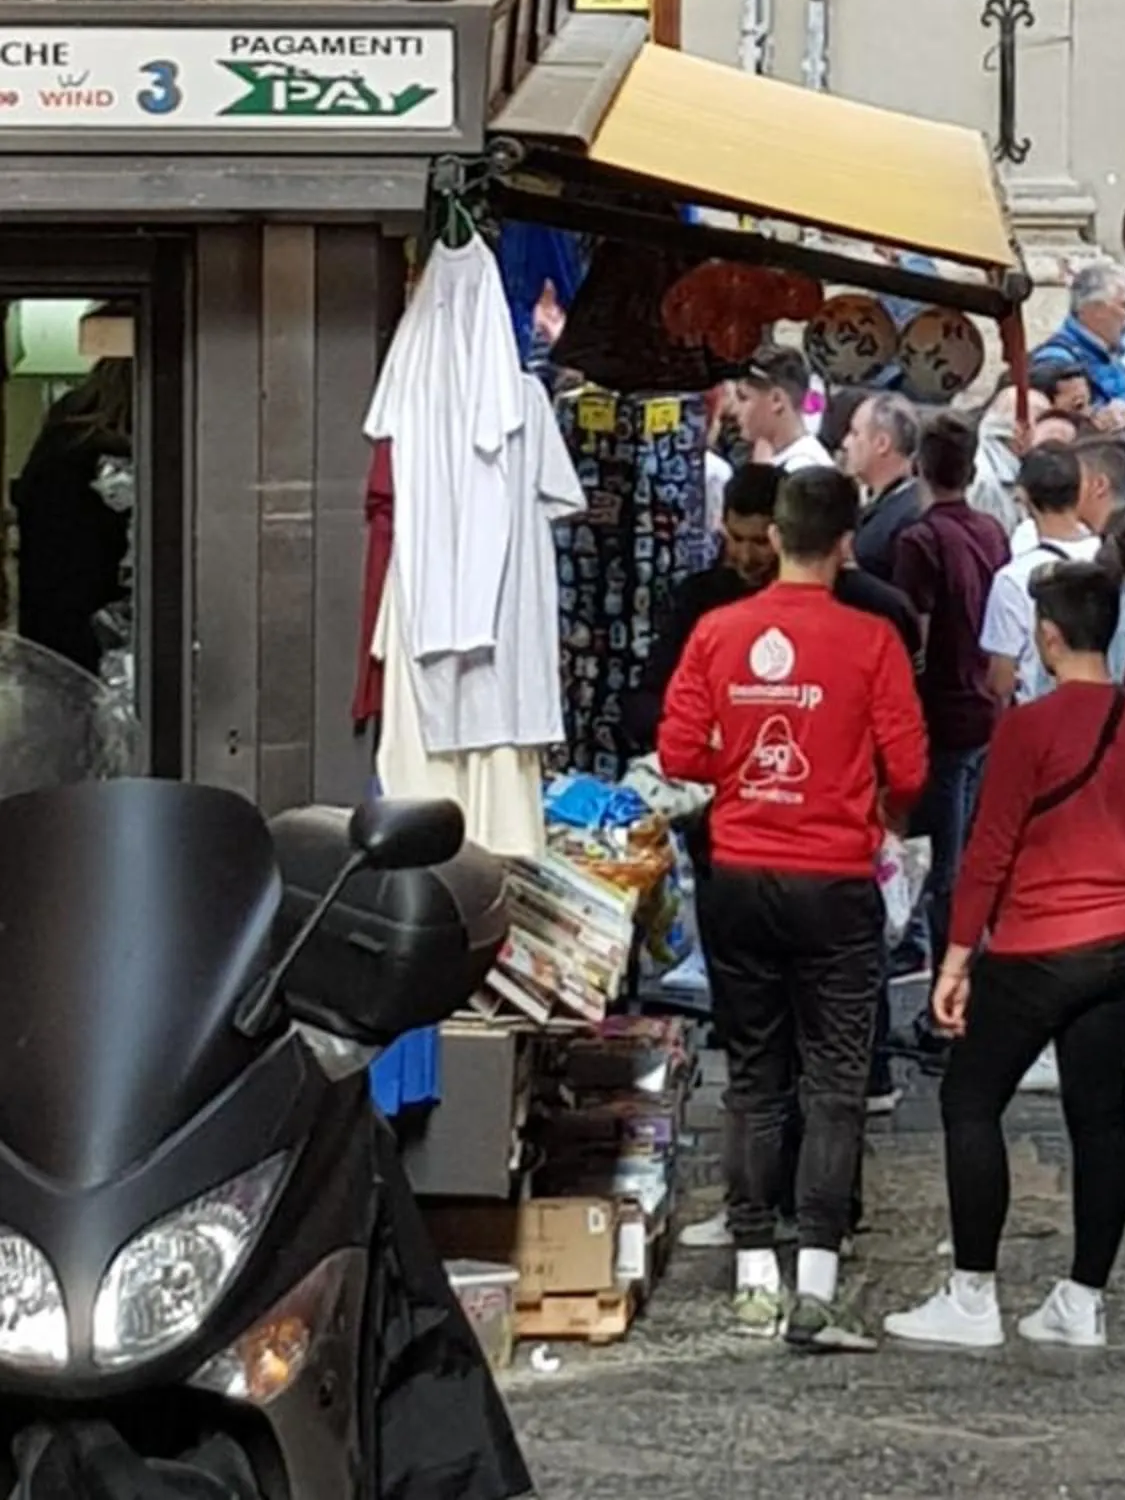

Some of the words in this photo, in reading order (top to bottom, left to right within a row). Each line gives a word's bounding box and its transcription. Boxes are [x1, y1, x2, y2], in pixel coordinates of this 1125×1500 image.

[0, 42, 70, 66] CHE
[230, 36, 424, 55] PAGAMENTI
[137, 59, 183, 115] 3
[38, 89, 114, 107] WIND
